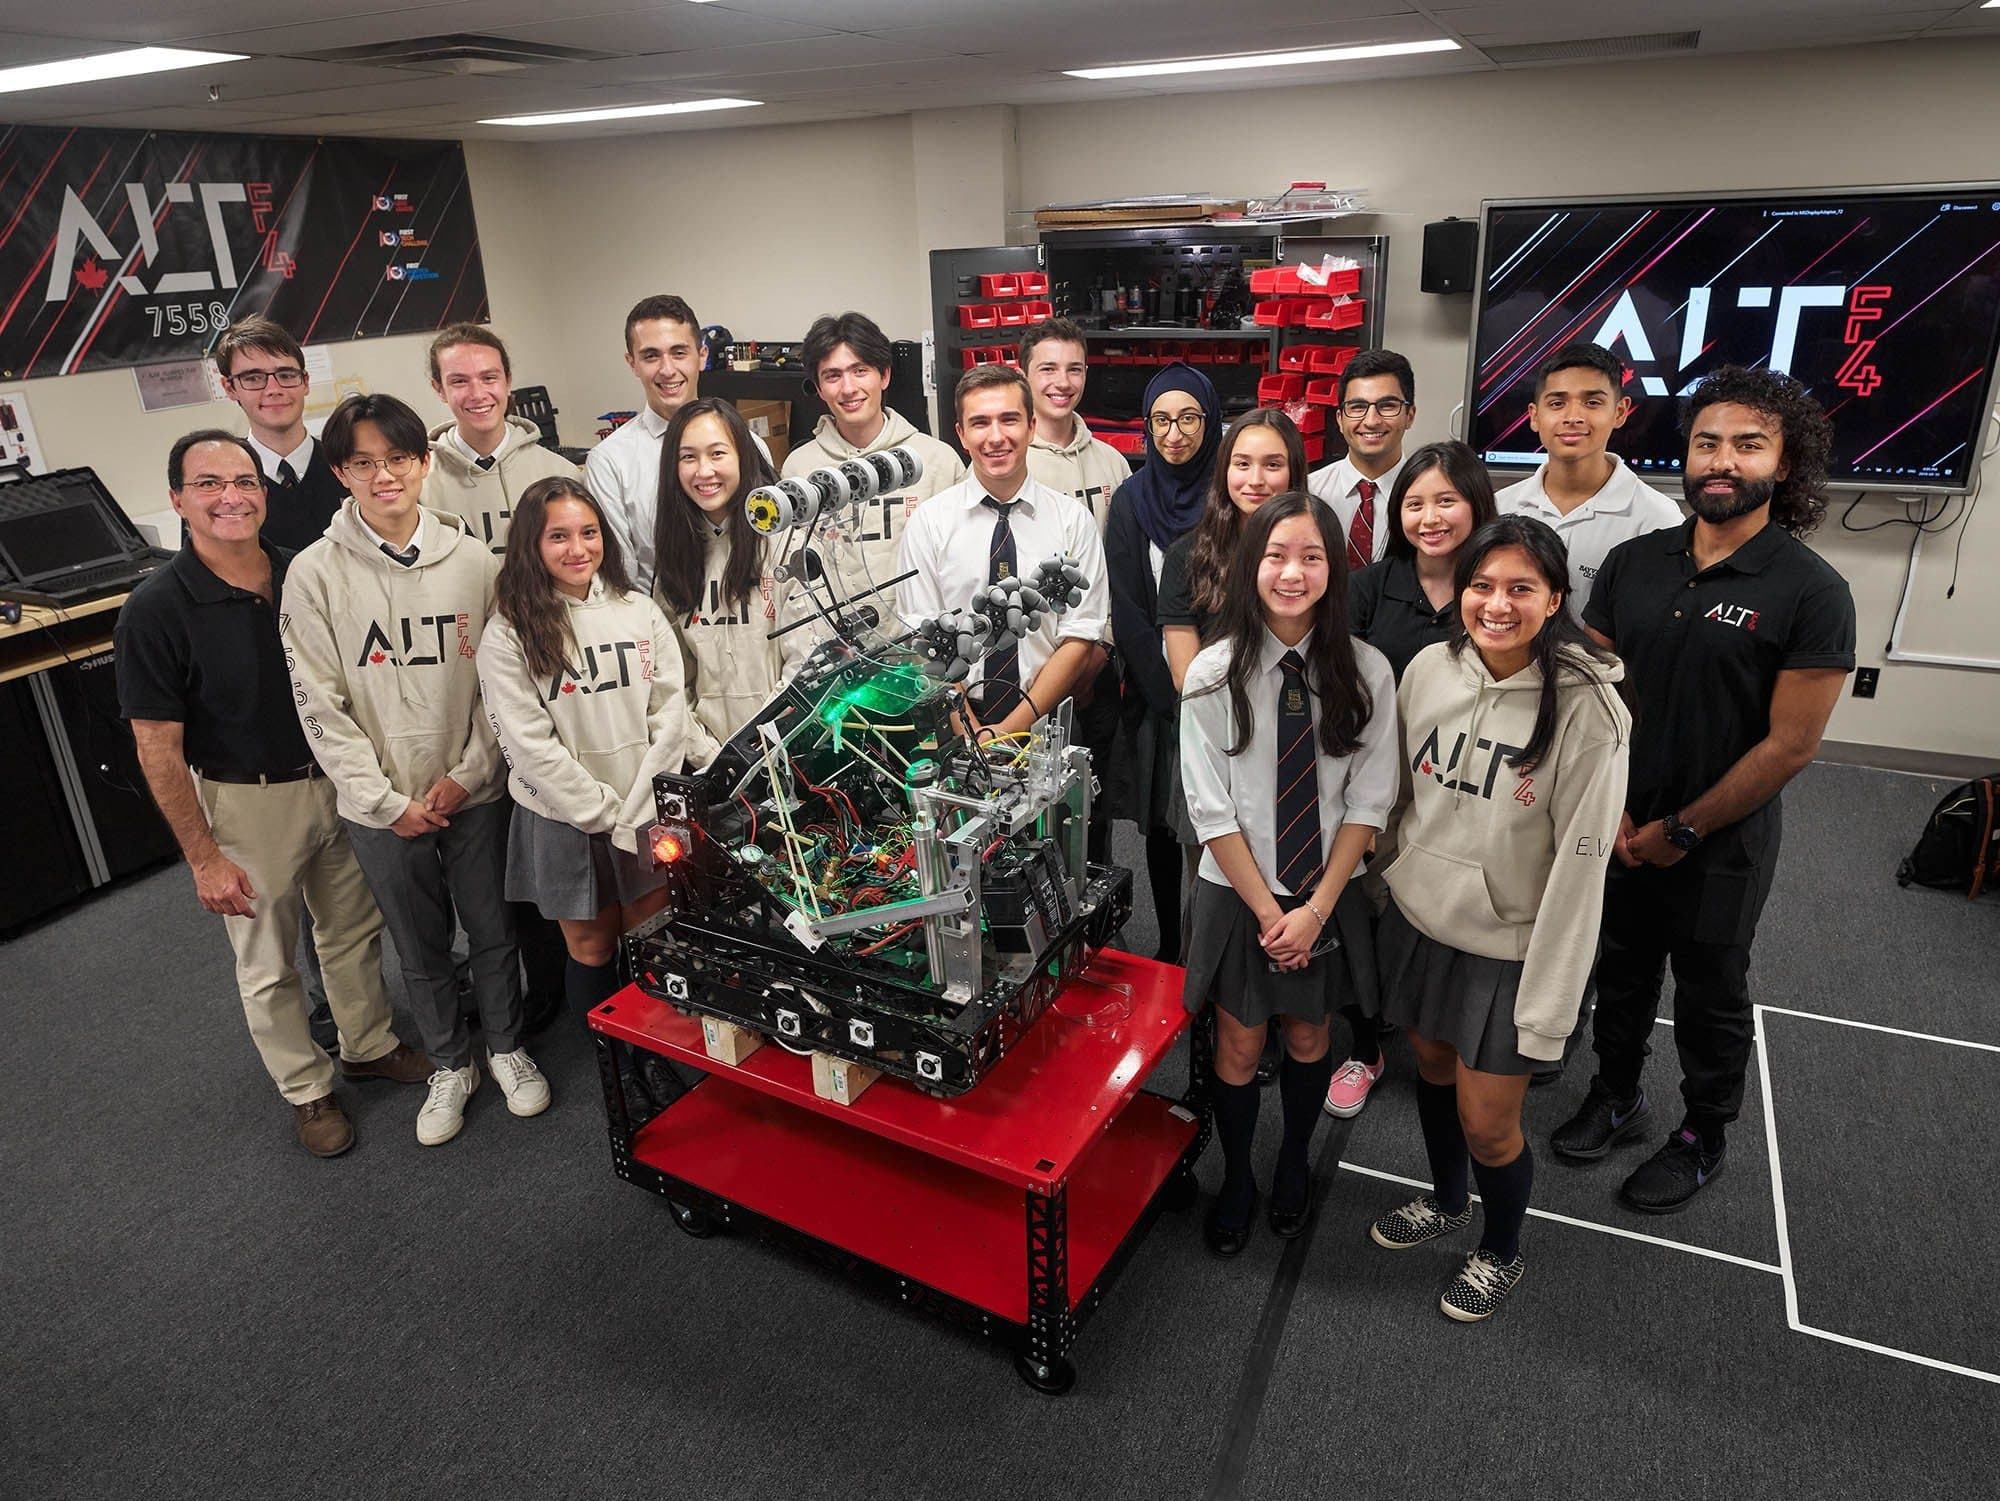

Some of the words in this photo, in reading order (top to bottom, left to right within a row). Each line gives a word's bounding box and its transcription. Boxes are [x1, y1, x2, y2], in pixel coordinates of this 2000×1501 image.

[46, 183, 248, 301] ALT
[145, 301, 230, 337] 7558
[357, 615, 456, 667] ALT
[1704, 602, 1754, 627] ALT
[548, 642, 636, 701] ALT
[1412, 726, 1525, 800] ALT
